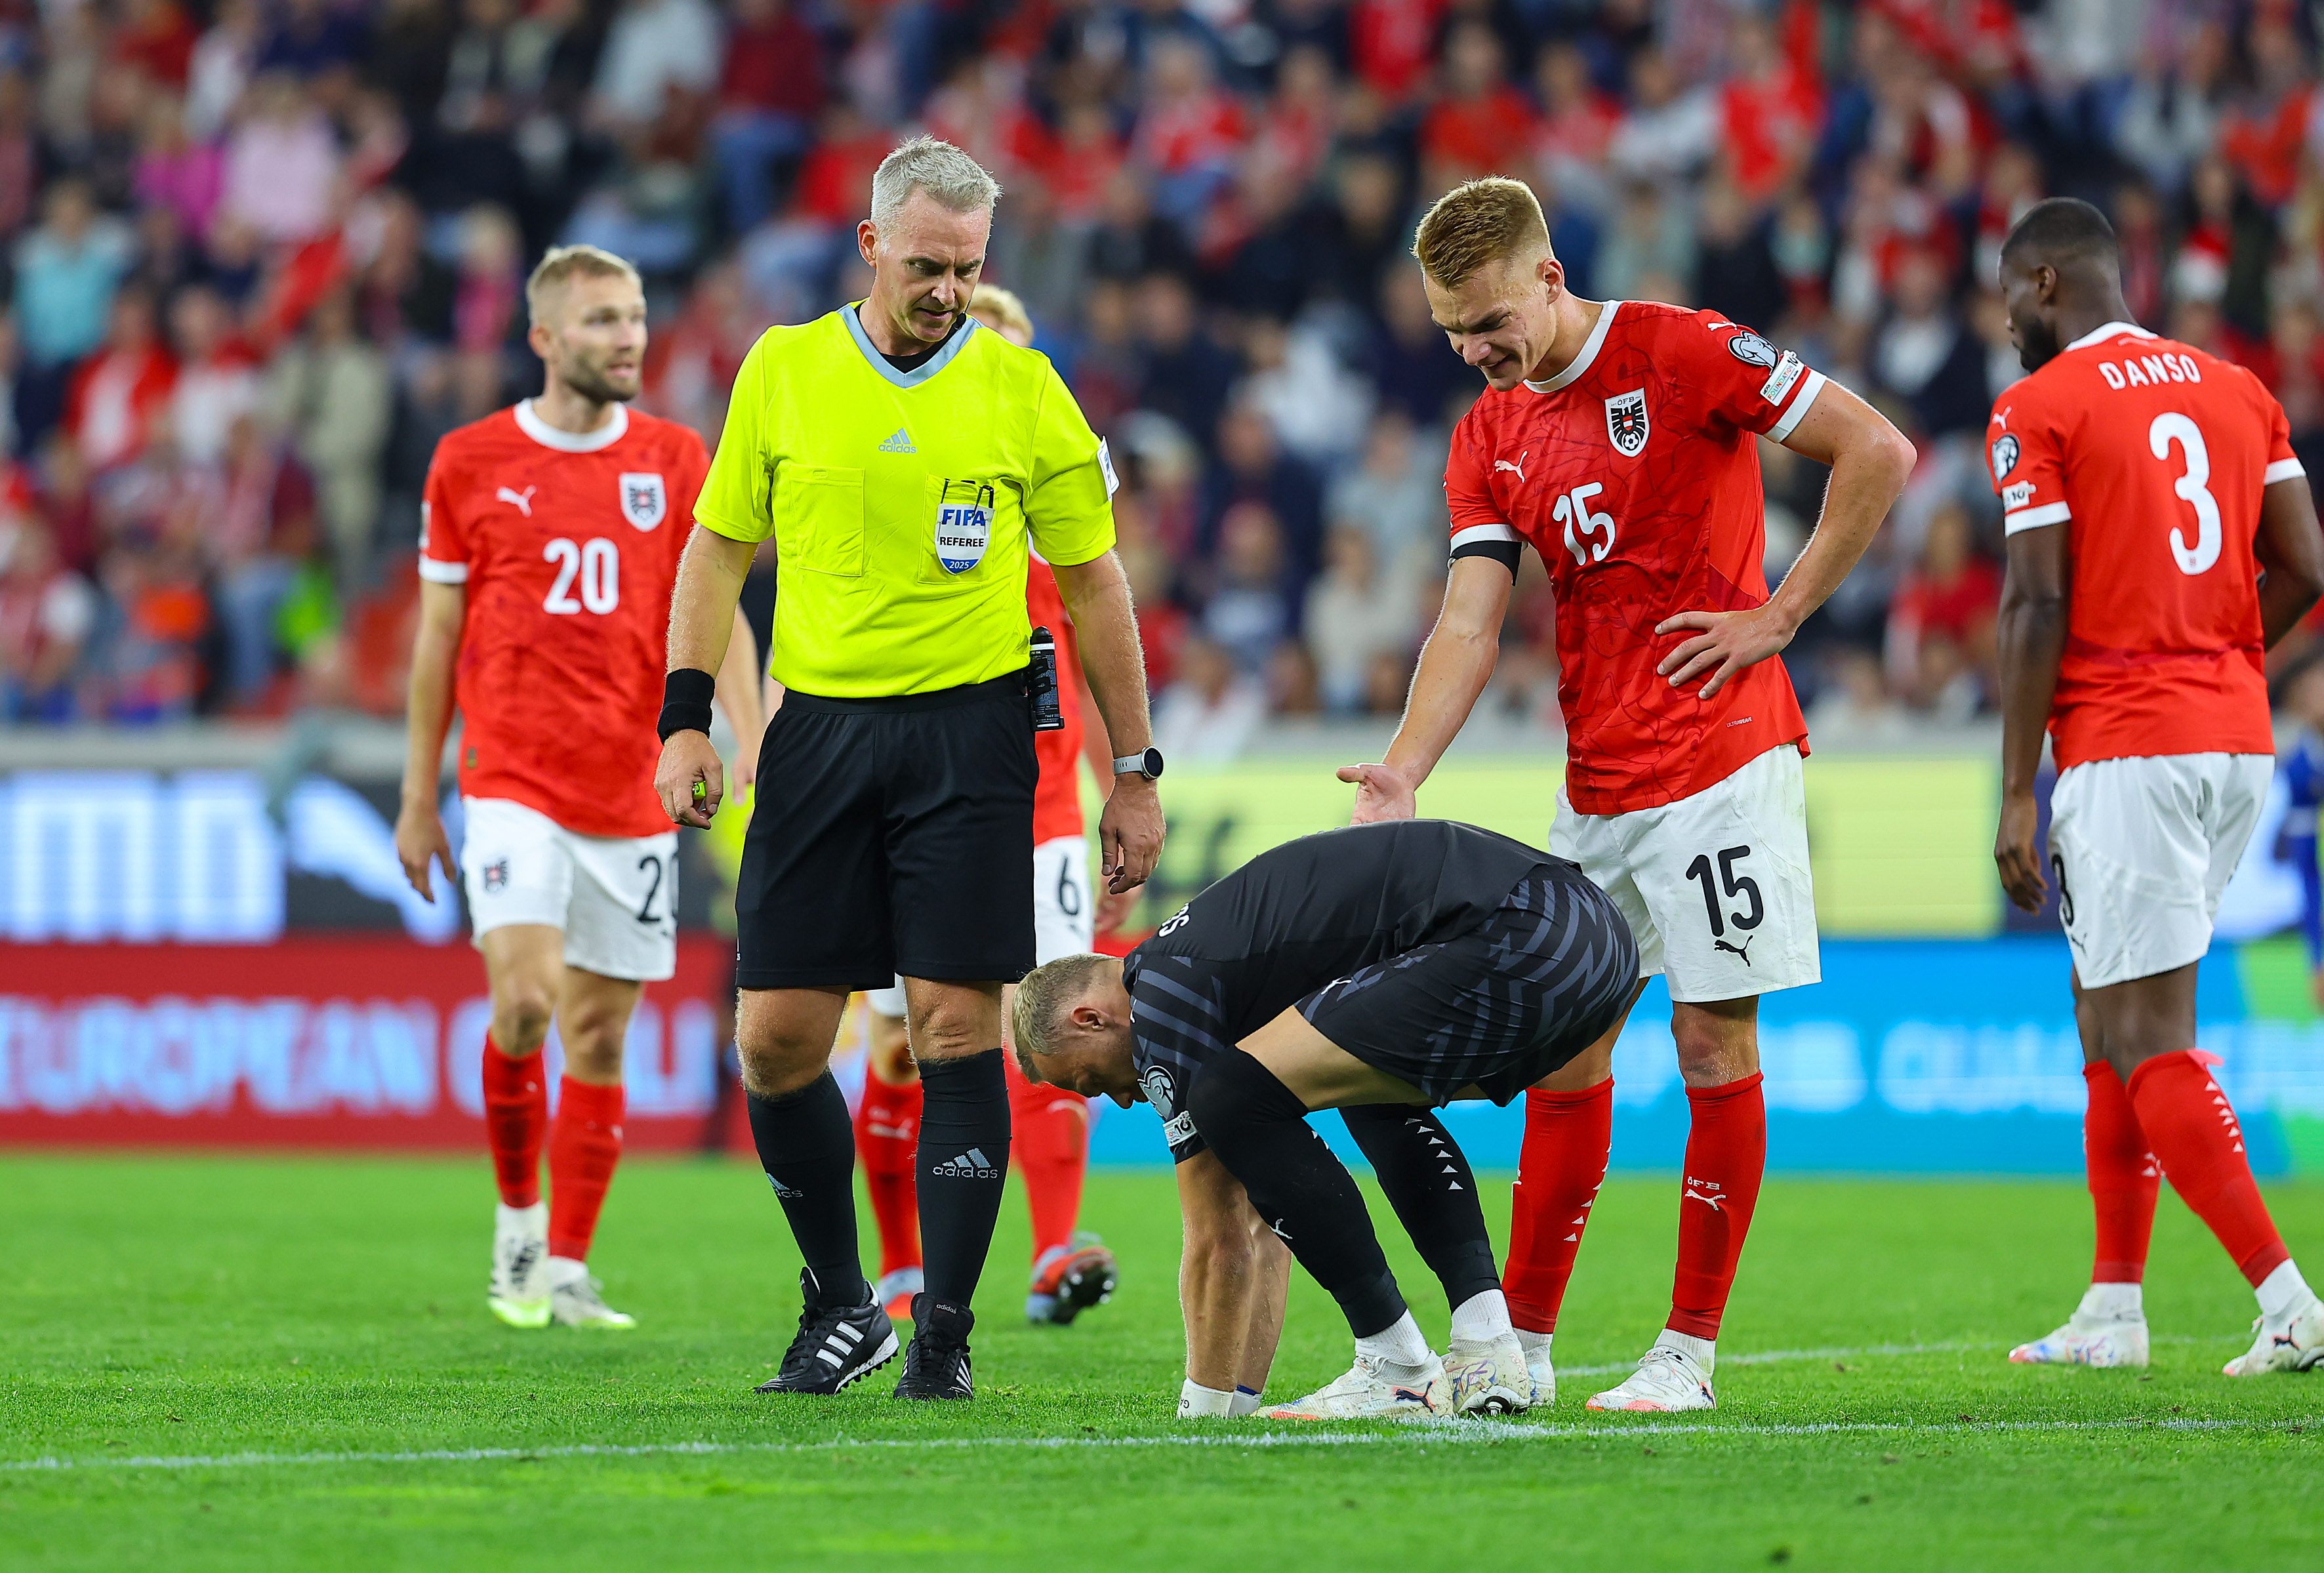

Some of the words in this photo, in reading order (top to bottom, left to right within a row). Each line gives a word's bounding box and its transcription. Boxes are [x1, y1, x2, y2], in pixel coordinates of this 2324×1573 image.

[1767, 364, 1794, 400] FOUNDATION
[2098, 353, 2202, 390] DANSO
[878, 443, 917, 454] adidas
[2148, 411, 2223, 576] 3
[941, 509, 986, 526] FIFA
[1553, 481, 1616, 566] 15
[939, 537, 985, 547] REFEREE
[542, 537, 621, 615] 20
[948, 561, 970, 569] 2025
[637, 855, 678, 924] 2
[1057, 854, 1081, 916] 6
[1685, 844, 1764, 937] 15
[932, 1165, 998, 1179] adidas
